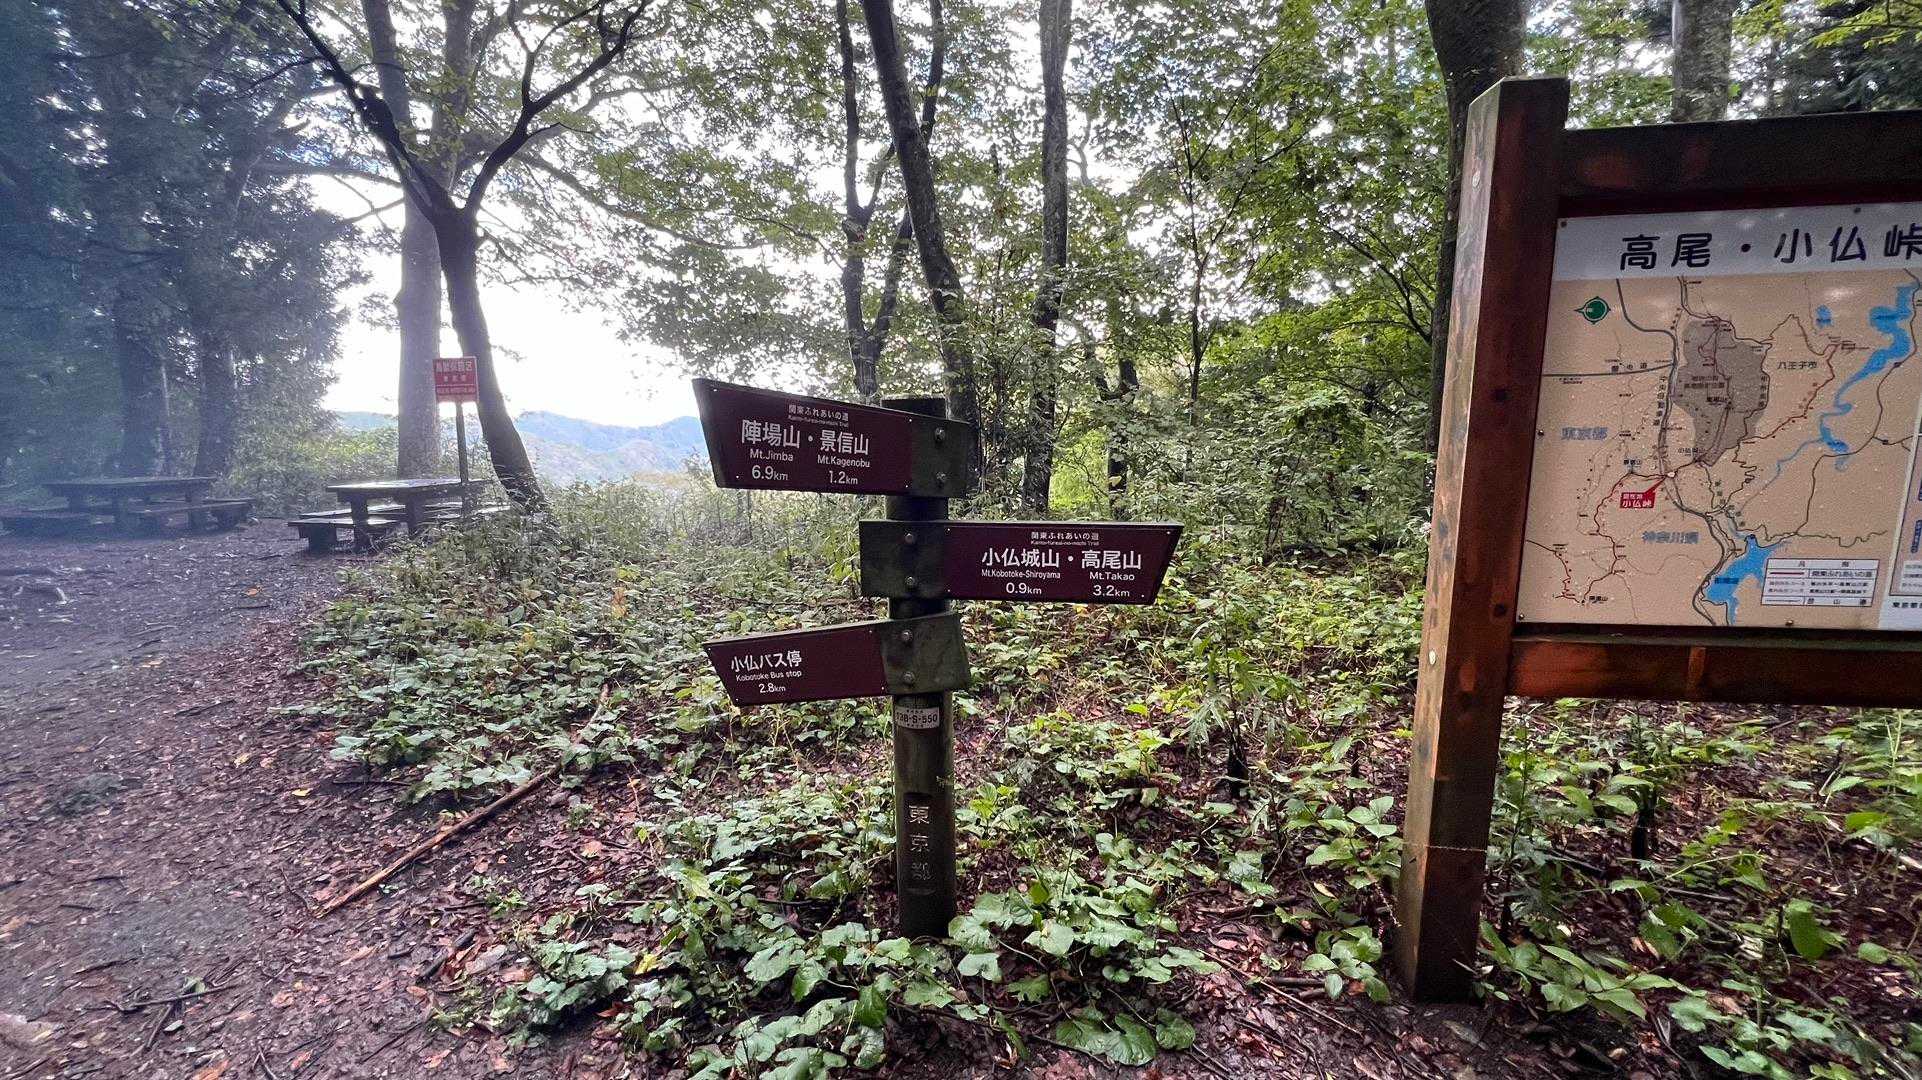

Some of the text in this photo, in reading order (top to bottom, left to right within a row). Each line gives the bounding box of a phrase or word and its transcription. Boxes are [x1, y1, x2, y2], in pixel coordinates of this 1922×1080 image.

[1619, 222, 1922, 271] 高尾・小仏峠
[788, 404, 849, 422] 関東ふれあいの道
[741, 418, 869, 456] 陣場山・景信山
[750, 448, 794, 462] Mt.Jimba
[817, 454, 871, 469] Mt.Kagenobu
[751, 464, 789, 481] 6.9km
[828, 470, 858, 485] 1.2km
[1031, 531, 1100, 541] 関東ふれあいの道
[981, 548, 1142, 570] 小仏城山・高尾山
[981, 569, 1061, 580] Mt.Kobotoke-Shiroyama
[1089, 571, 1135, 581] Mt.Takao
[1005, 582, 1042, 595] 0.9km
[1093, 584, 1130, 597] 3.2km
[731, 650, 802, 673] 小仏バス停
[735, 670, 802, 682] Kobotoke Bus stop
[758, 682, 786, 694] 2.8km
